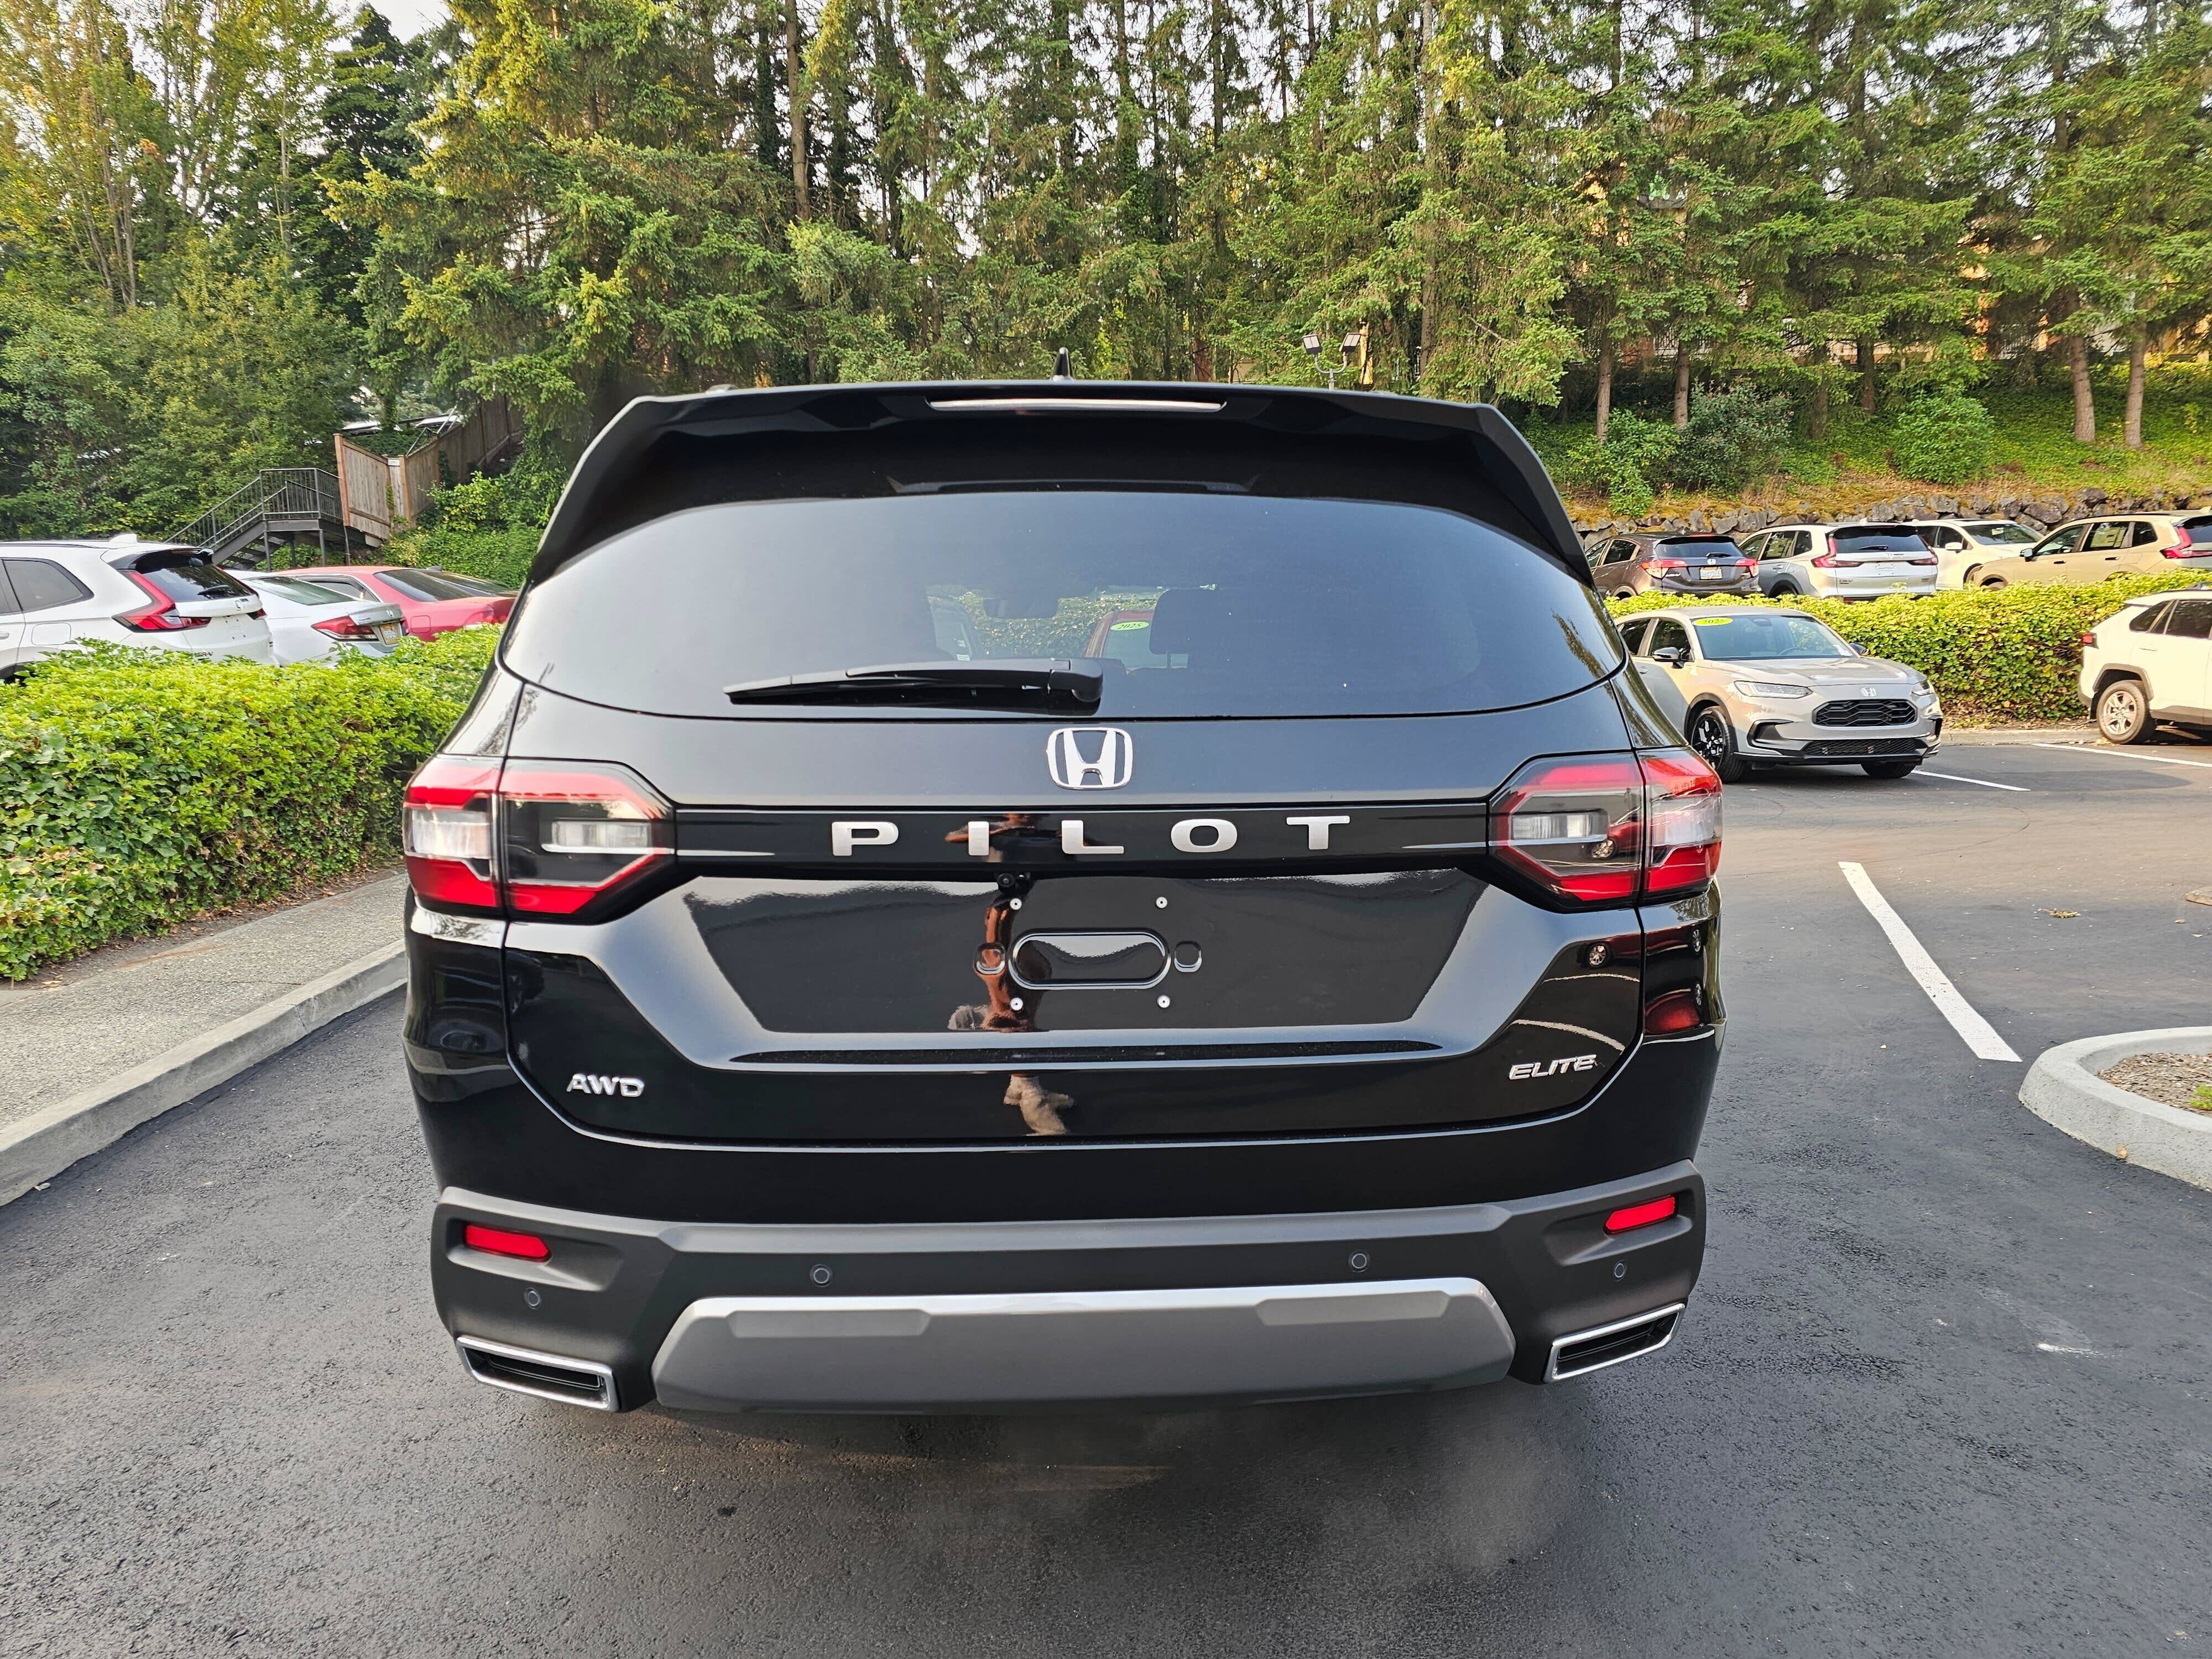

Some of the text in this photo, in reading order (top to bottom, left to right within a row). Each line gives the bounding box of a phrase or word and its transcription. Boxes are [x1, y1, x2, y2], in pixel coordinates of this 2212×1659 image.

[831, 815, 1350, 856] PILOT
[1509, 1053, 1598, 1081] ELITE
[566, 1072, 645, 1098] AWD
